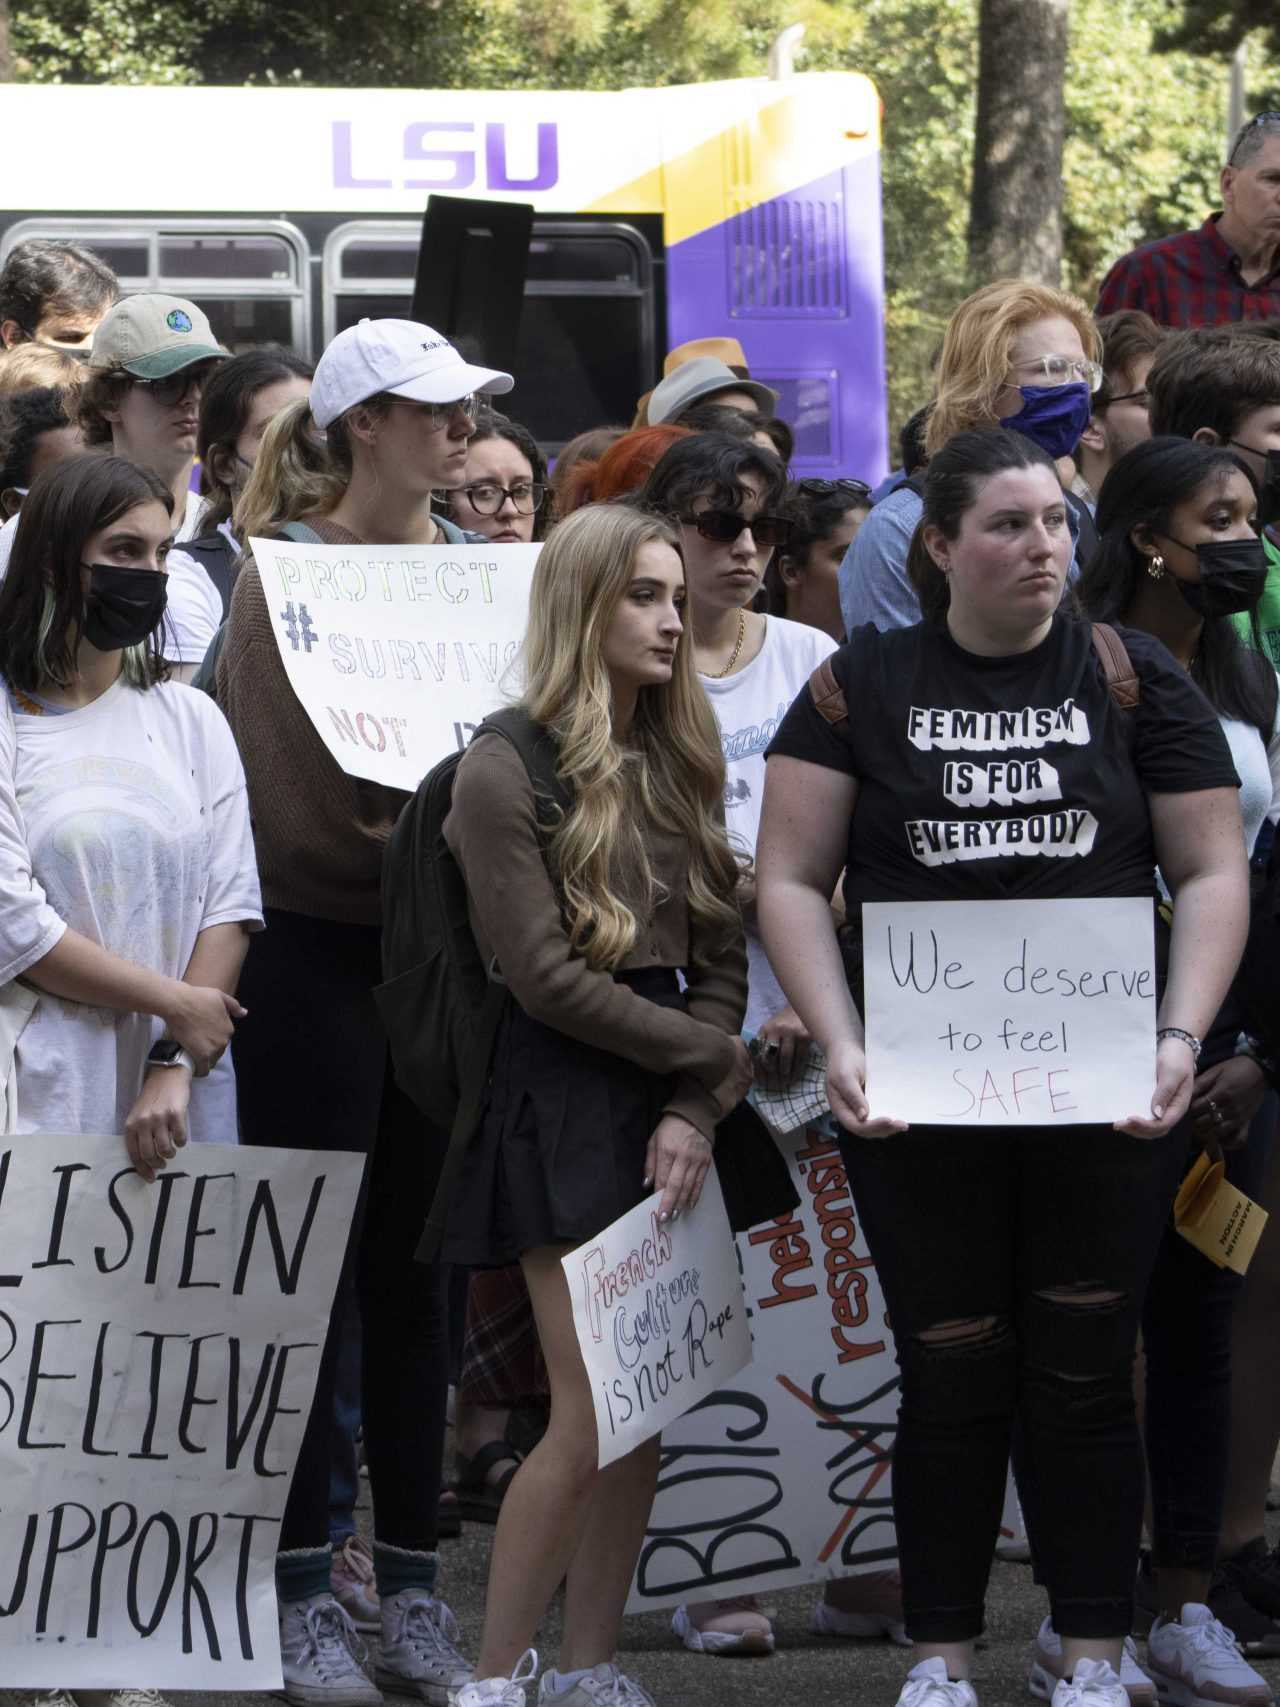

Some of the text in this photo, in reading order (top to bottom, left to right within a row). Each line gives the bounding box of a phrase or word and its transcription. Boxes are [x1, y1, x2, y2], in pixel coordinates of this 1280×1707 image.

[331, 120, 559, 191] LSU
[274, 555, 499, 604] PROTECT
[326, 706, 407, 757] NOT
[908, 699, 1082, 745] FEMINISM
[944, 758, 1049, 798] IS FOR
[905, 810, 1091, 860] EVERYBODY
[888, 925, 1155, 998] We deserve
[938, 1018, 1067, 1052] to feel
[936, 1066, 1078, 1118] SAFE
[582, 1210, 672, 1342] French
[748, 1211, 818, 1309] hel
